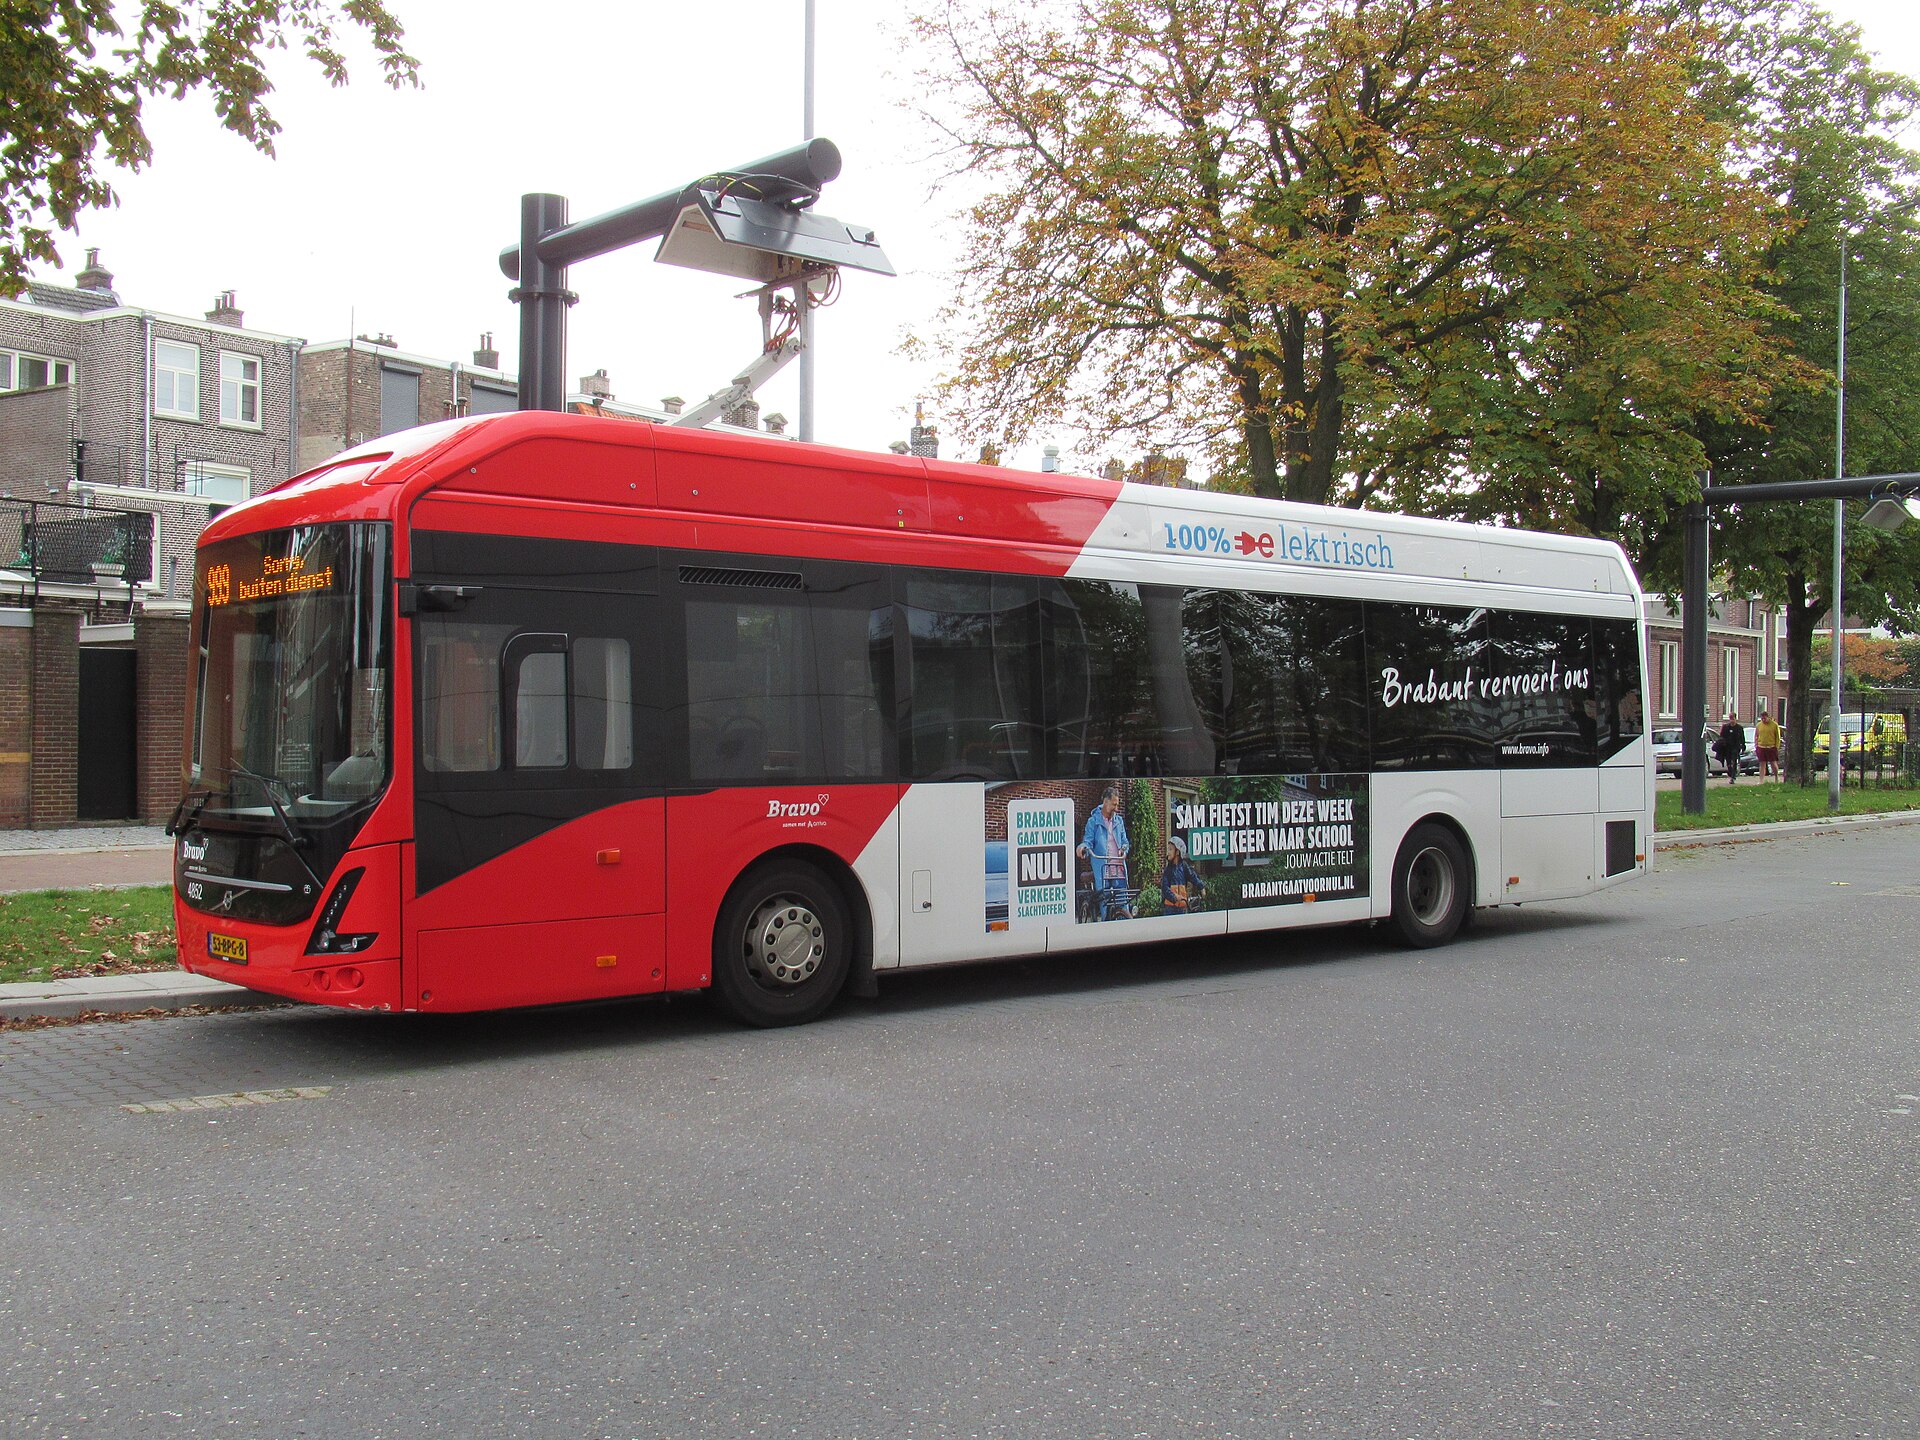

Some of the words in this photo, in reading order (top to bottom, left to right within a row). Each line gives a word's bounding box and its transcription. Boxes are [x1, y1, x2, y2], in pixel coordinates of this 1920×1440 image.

[1164, 522, 1231, 554] 100%
[207, 563, 230, 606] 999
[239, 577, 282, 599] buiten
[285, 566, 333, 592] dienst
[1381, 666, 1474, 708] Brabant
[1479, 659, 1559, 699] vervoert
[1564, 667, 1589, 691] ons
[1501, 742, 1550, 757] www.bravo.info
[766, 799, 820, 818] Bravo
[1176, 804, 1206, 829] SAM
[1209, 803, 1251, 827] FIETST
[1255, 801, 1278, 825] TIM
[1282, 800, 1314, 824] DEZE
[1317, 799, 1353, 822] WEEK
[1016, 810, 1066, 829] BRABANT
[1017, 830, 1039, 846] GAAT
[1042, 829, 1066, 844] VOOR
[1192, 831, 1226, 856] DRIE
[1230, 829, 1265, 853] KEER
[1268, 827, 1305, 852] NAAR
[1307, 824, 1354, 849] SCHOOL
[183, 840, 205, 860] Bravo
[1285, 852, 1313, 870] JOUW
[1313, 850, 1336, 867] ACTIE
[1338, 849, 1354, 865] TELT
[1021, 851, 1062, 881] NUL
[187, 882, 203, 900] 4852
[1017, 886, 1067, 904] VERKEERS
[1242, 875, 1354, 899] BRABANTGAATVOORNUL.NL
[1017, 903, 1067, 918] SLACHTOFFERS
[212, 935, 245, 957] 53-BPG-8
